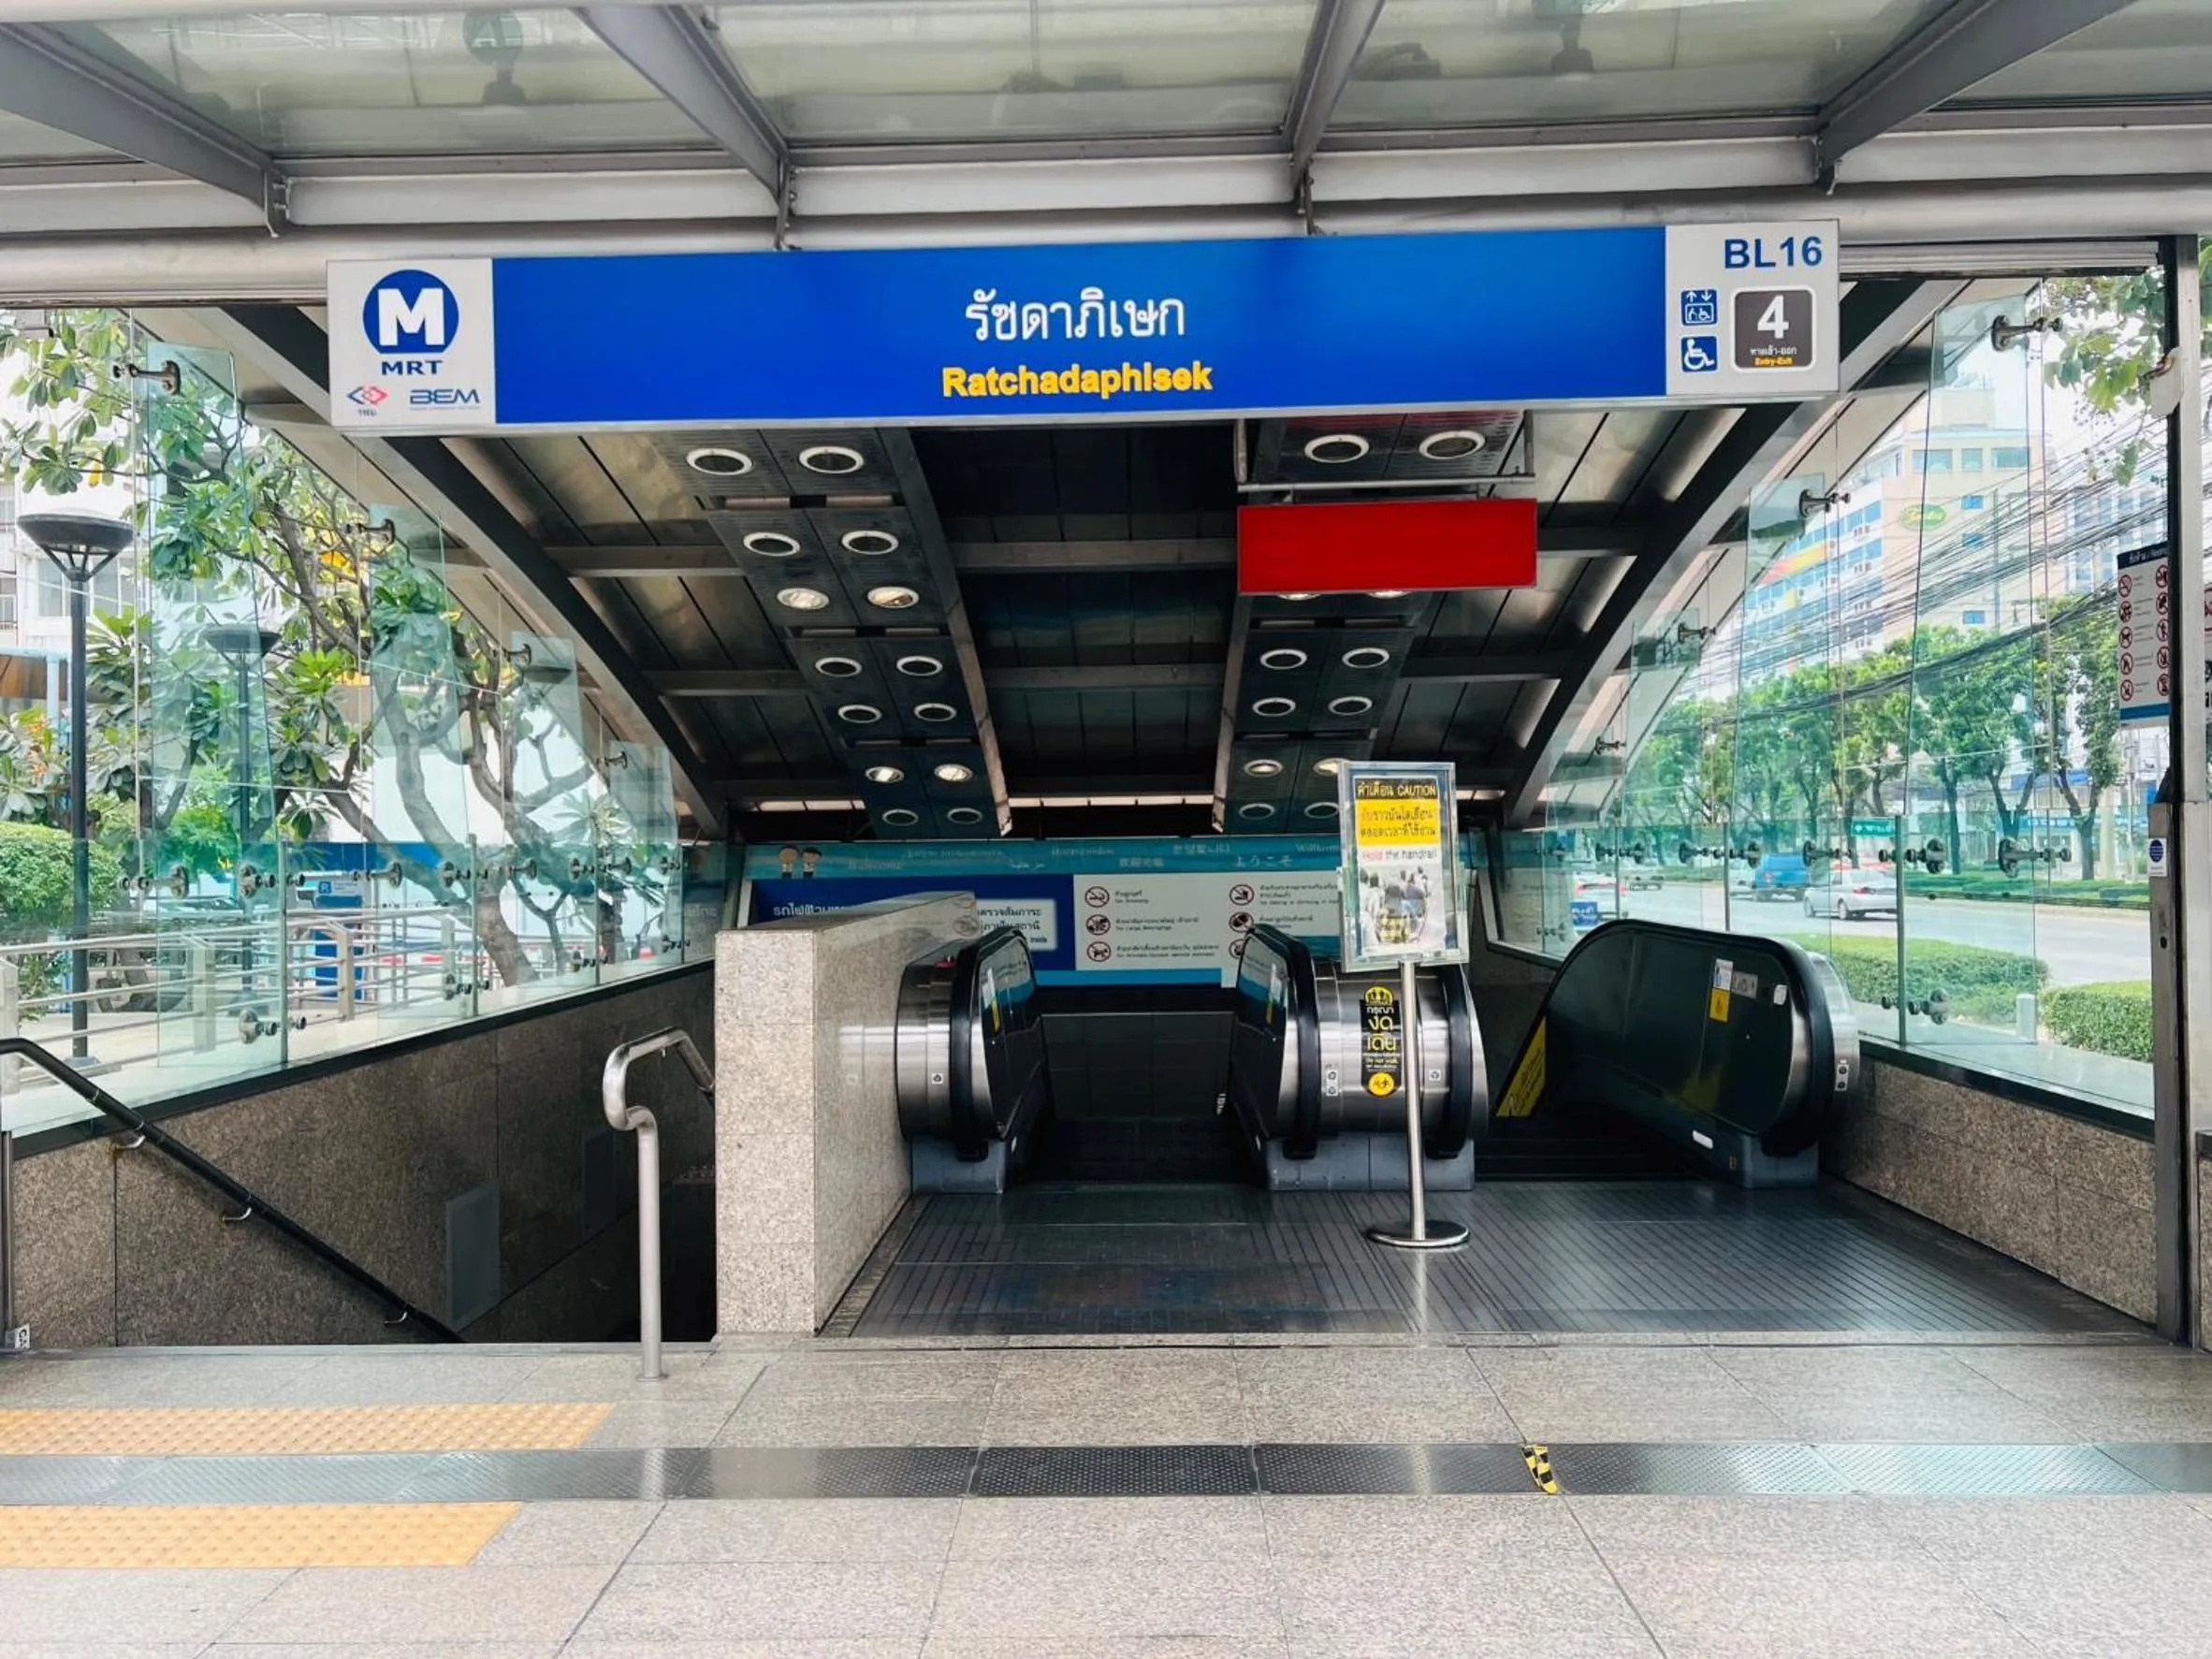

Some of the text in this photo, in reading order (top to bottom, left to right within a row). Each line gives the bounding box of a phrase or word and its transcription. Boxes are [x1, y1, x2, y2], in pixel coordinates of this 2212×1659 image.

[1724, 236, 1823, 269] BL16
[965, 286, 1186, 342] รัชดาภิเษก
[1757, 295, 1789, 339] 4
[381, 360, 444, 376] MRT
[941, 360, 1214, 400] Ratchadaphisek
[409, 388, 481, 405] BEM
[1397, 784, 1437, 797] CAUTION
